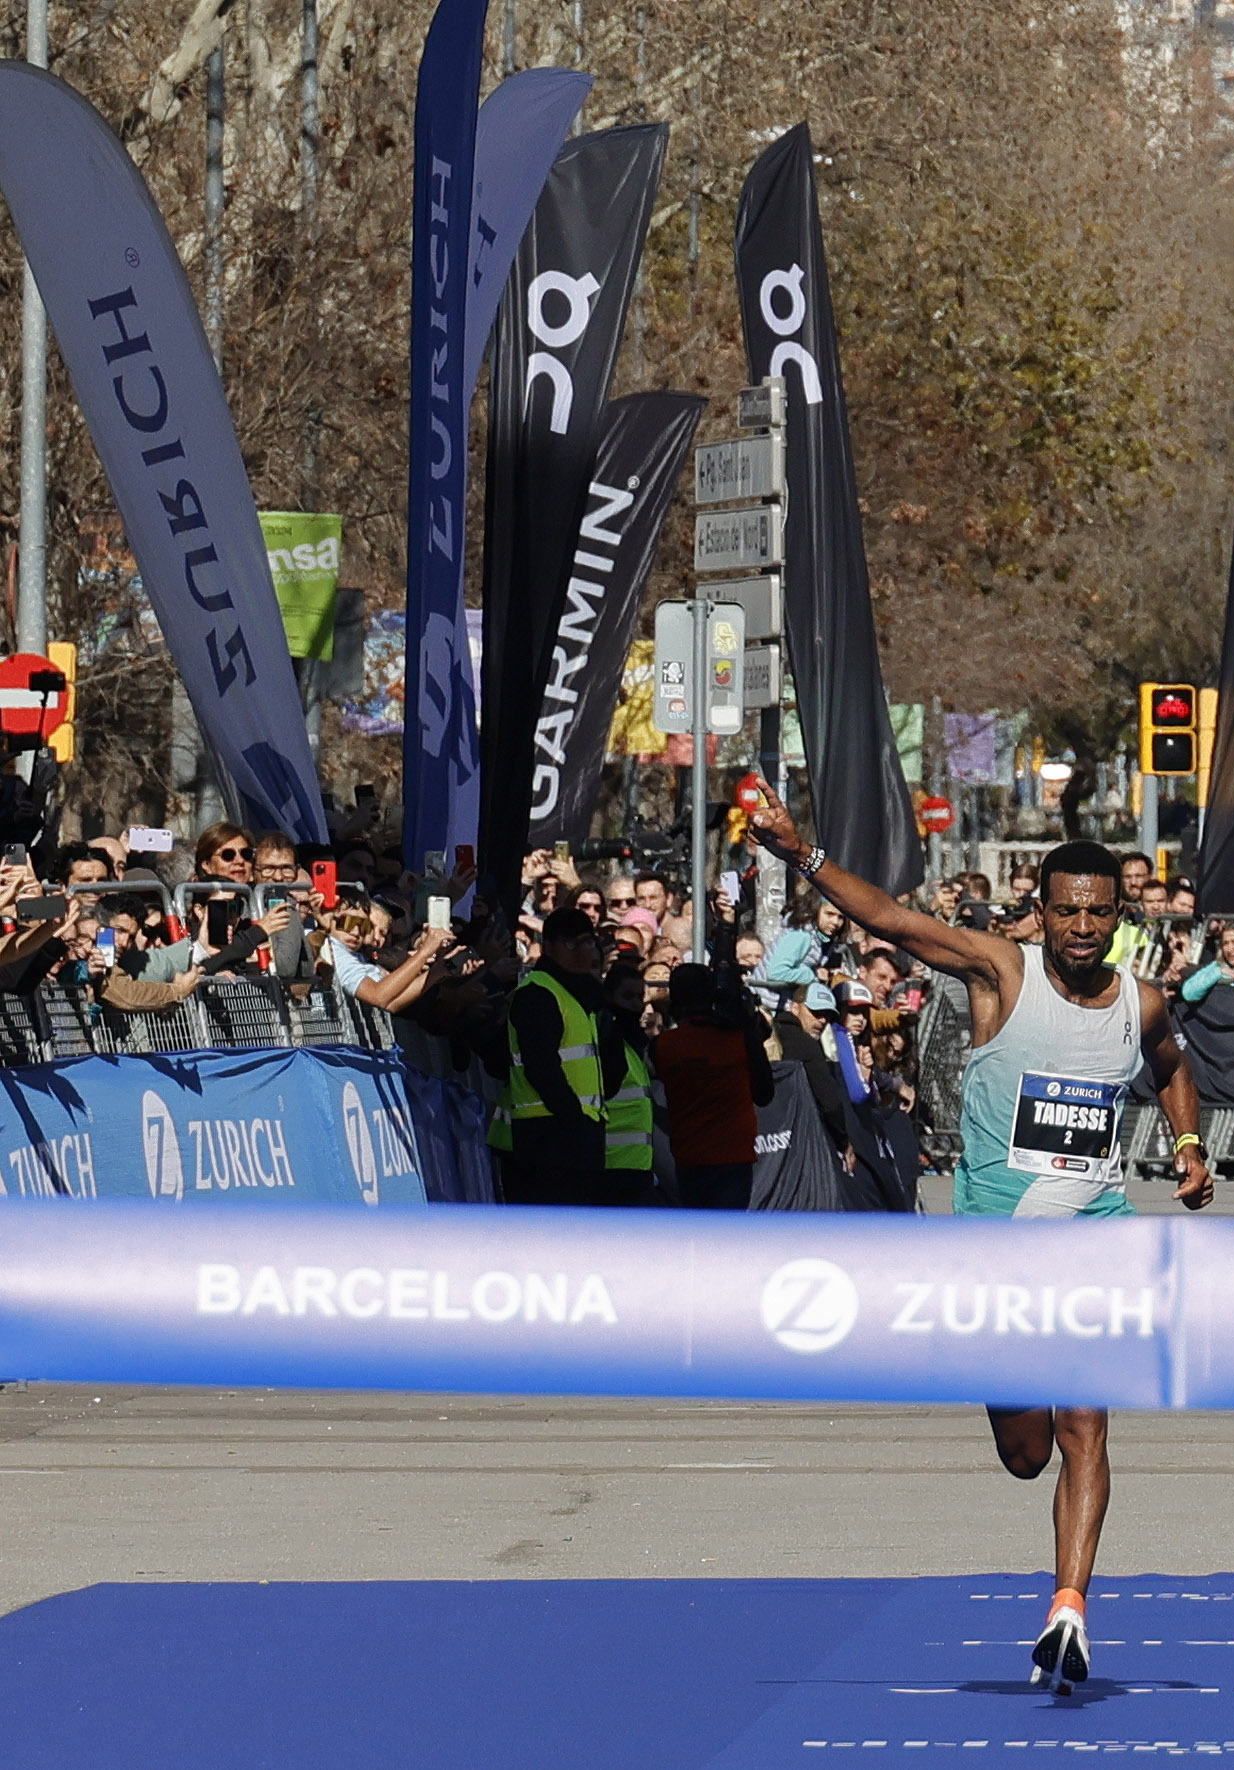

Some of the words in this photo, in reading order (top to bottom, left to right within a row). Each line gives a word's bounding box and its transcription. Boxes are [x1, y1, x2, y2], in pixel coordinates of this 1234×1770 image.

[529, 480, 634, 820] GARMIN
[1033, 1100, 1109, 1131] TADESSE
[1063, 1086, 1103, 1099] ZURICH
[189, 1118, 296, 1190] ZURICH
[1063, 1130, 1074, 1145] 2
[196, 1263, 618, 1325] BARCELONA
[889, 1282, 1156, 1338] ZURICH
